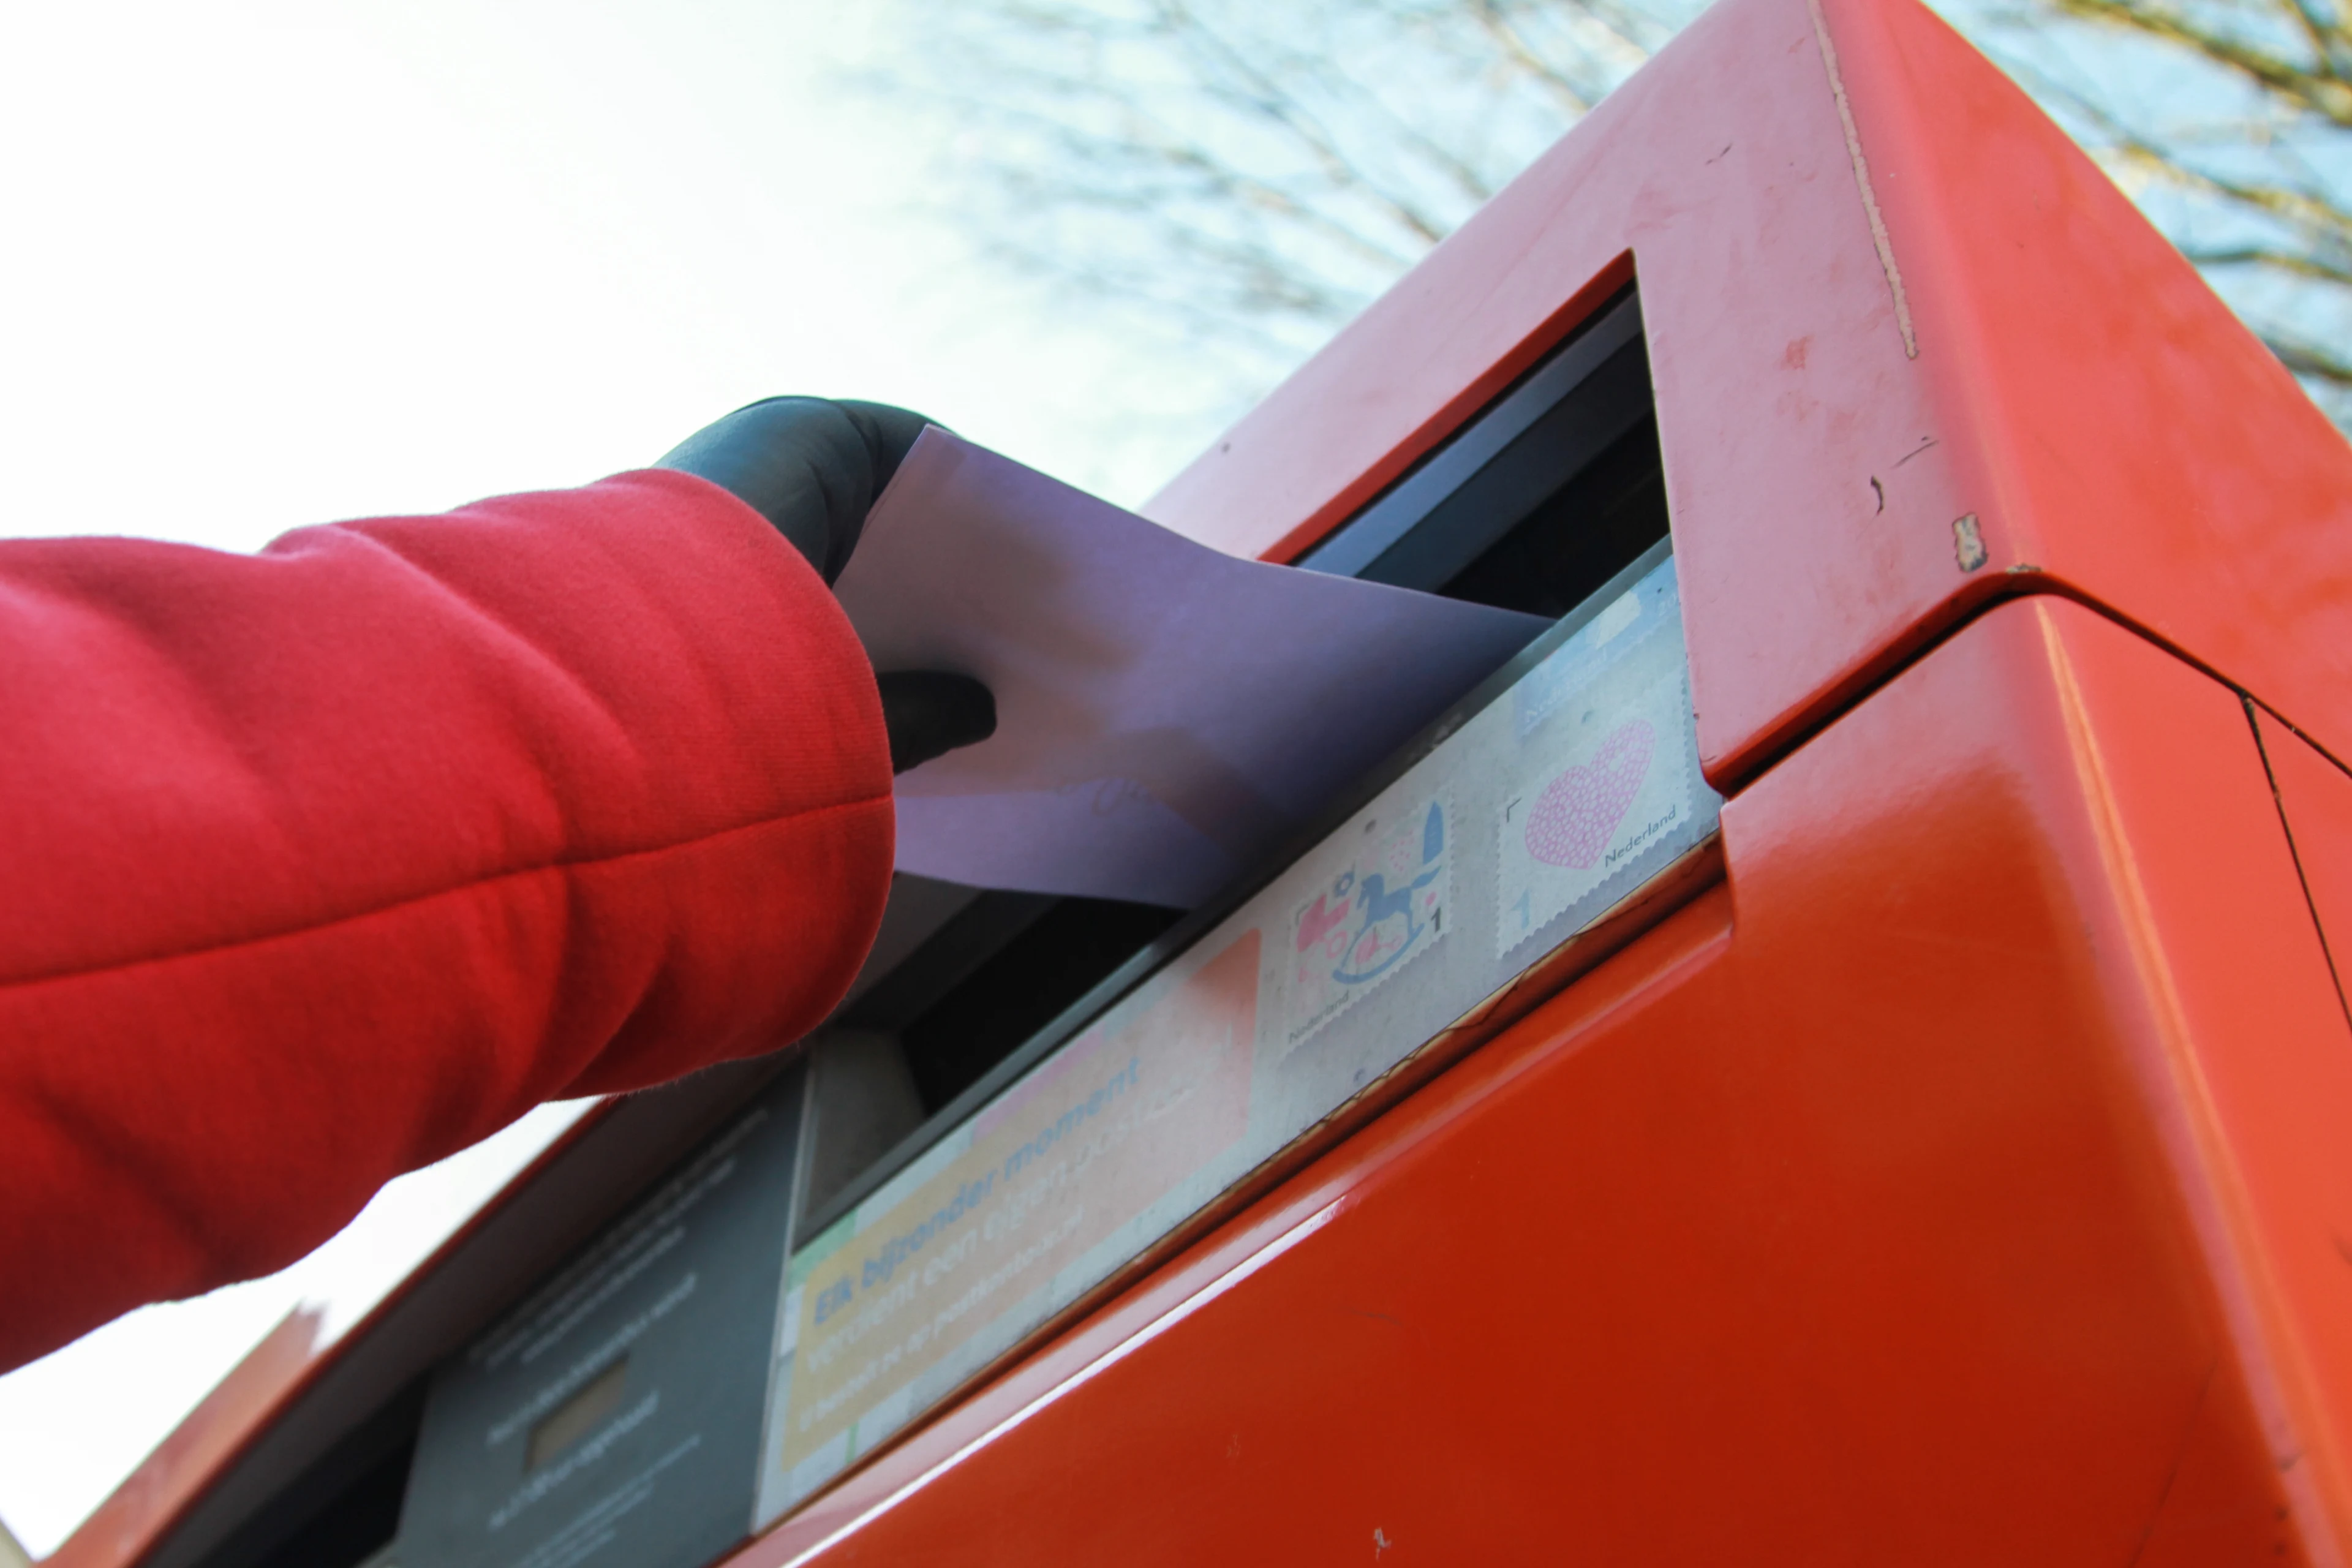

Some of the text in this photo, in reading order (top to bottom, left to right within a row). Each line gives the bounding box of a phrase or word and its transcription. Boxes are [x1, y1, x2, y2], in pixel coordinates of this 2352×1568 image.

[1604, 804, 1677, 869] Nederland
[1430, 905, 1442, 934] 1
[1288, 989, 1350, 1045] Nederland
[813, 1270, 855, 1328] Elk
[861, 1167, 998, 1290] bijzonder
[1003, 1055, 1140, 1183] moment
[923, 1228, 978, 1287] een
[983, 1160, 1067, 1242] eigen
